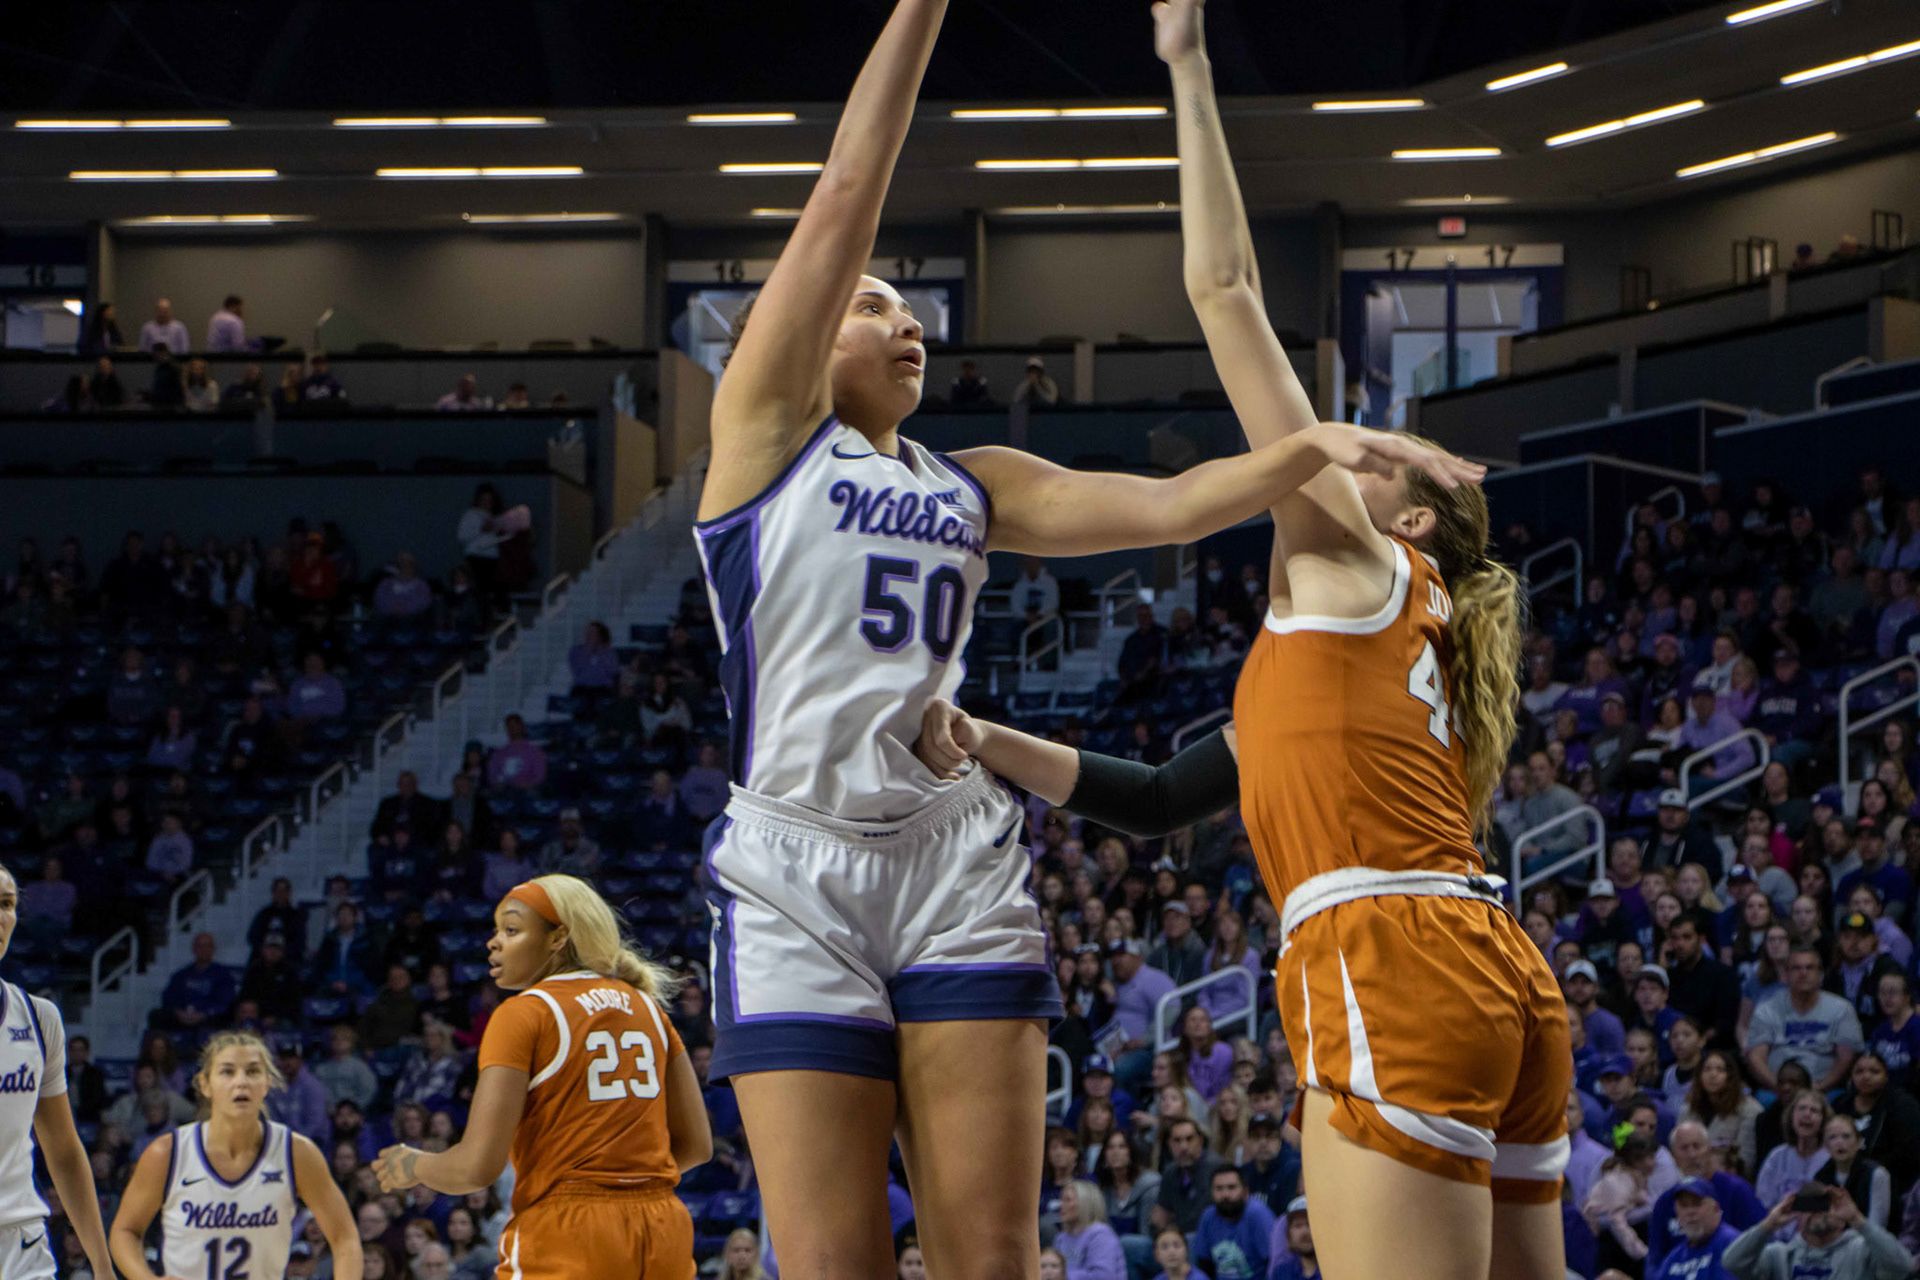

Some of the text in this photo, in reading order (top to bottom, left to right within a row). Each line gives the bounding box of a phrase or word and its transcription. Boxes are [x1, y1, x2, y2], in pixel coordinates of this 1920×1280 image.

[894, 256, 925, 280] 17
[1385, 248, 1417, 271] 17
[1484, 243, 1516, 268] 17
[714, 260, 744, 282] 16
[859, 553, 966, 663] 50
[574, 988, 634, 1016] MOORE
[585, 1030, 661, 1102] 23
[181, 1201, 279, 1229] Wildcats
[205, 1236, 252, 1280] 12
